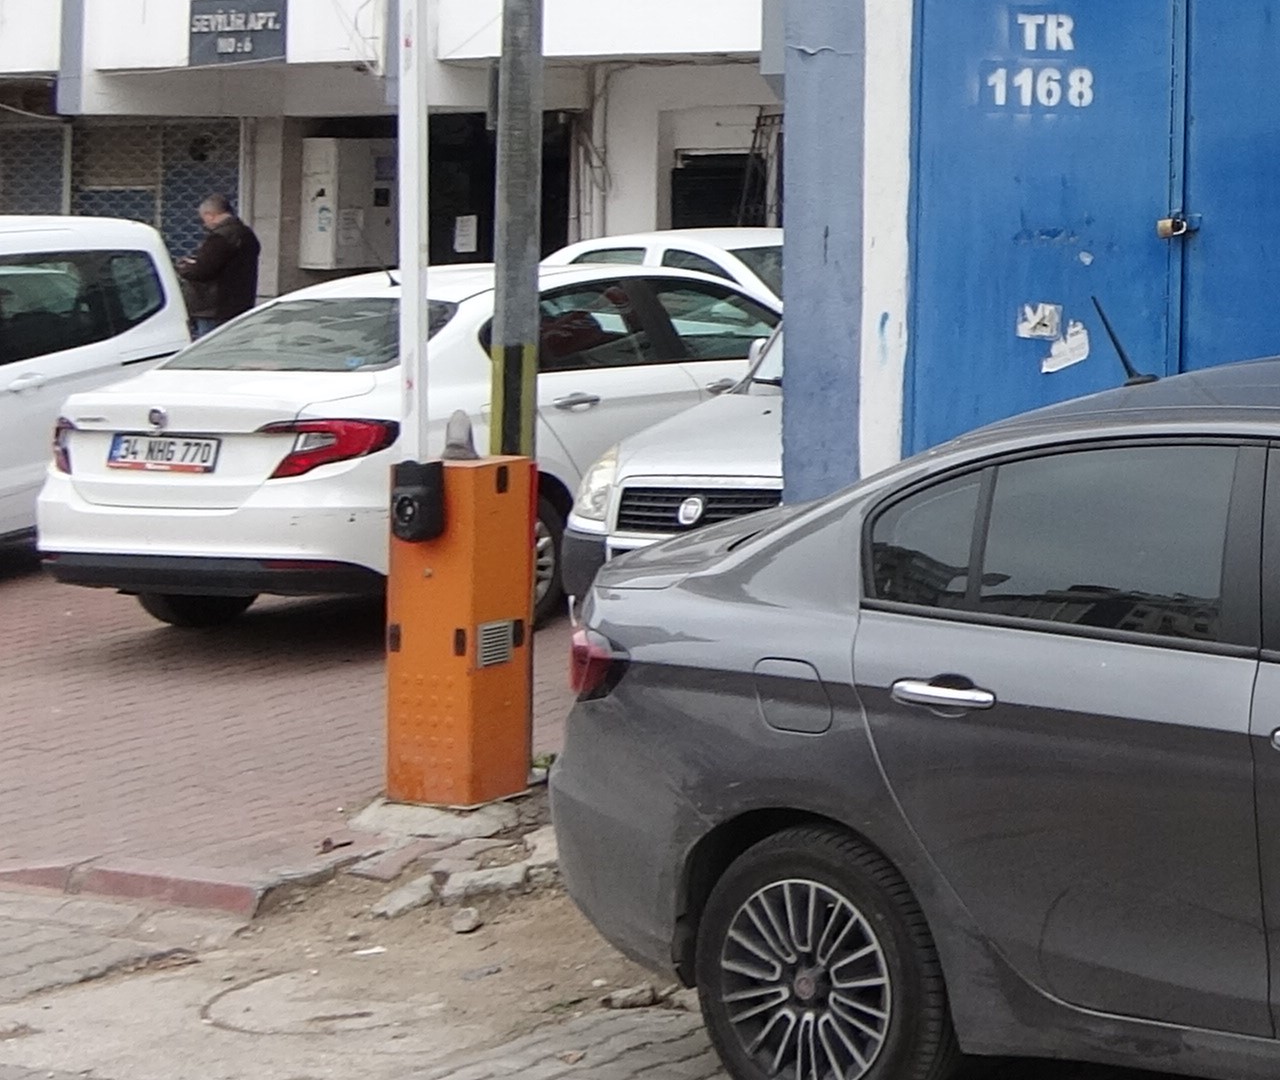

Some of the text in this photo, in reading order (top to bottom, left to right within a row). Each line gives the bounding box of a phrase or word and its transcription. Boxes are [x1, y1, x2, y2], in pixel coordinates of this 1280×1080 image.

[1017, 13, 1074, 51] TR
[987, 67, 1094, 107] 1168
[120, 439, 138, 460] 34
[181, 442, 213, 464] 770
